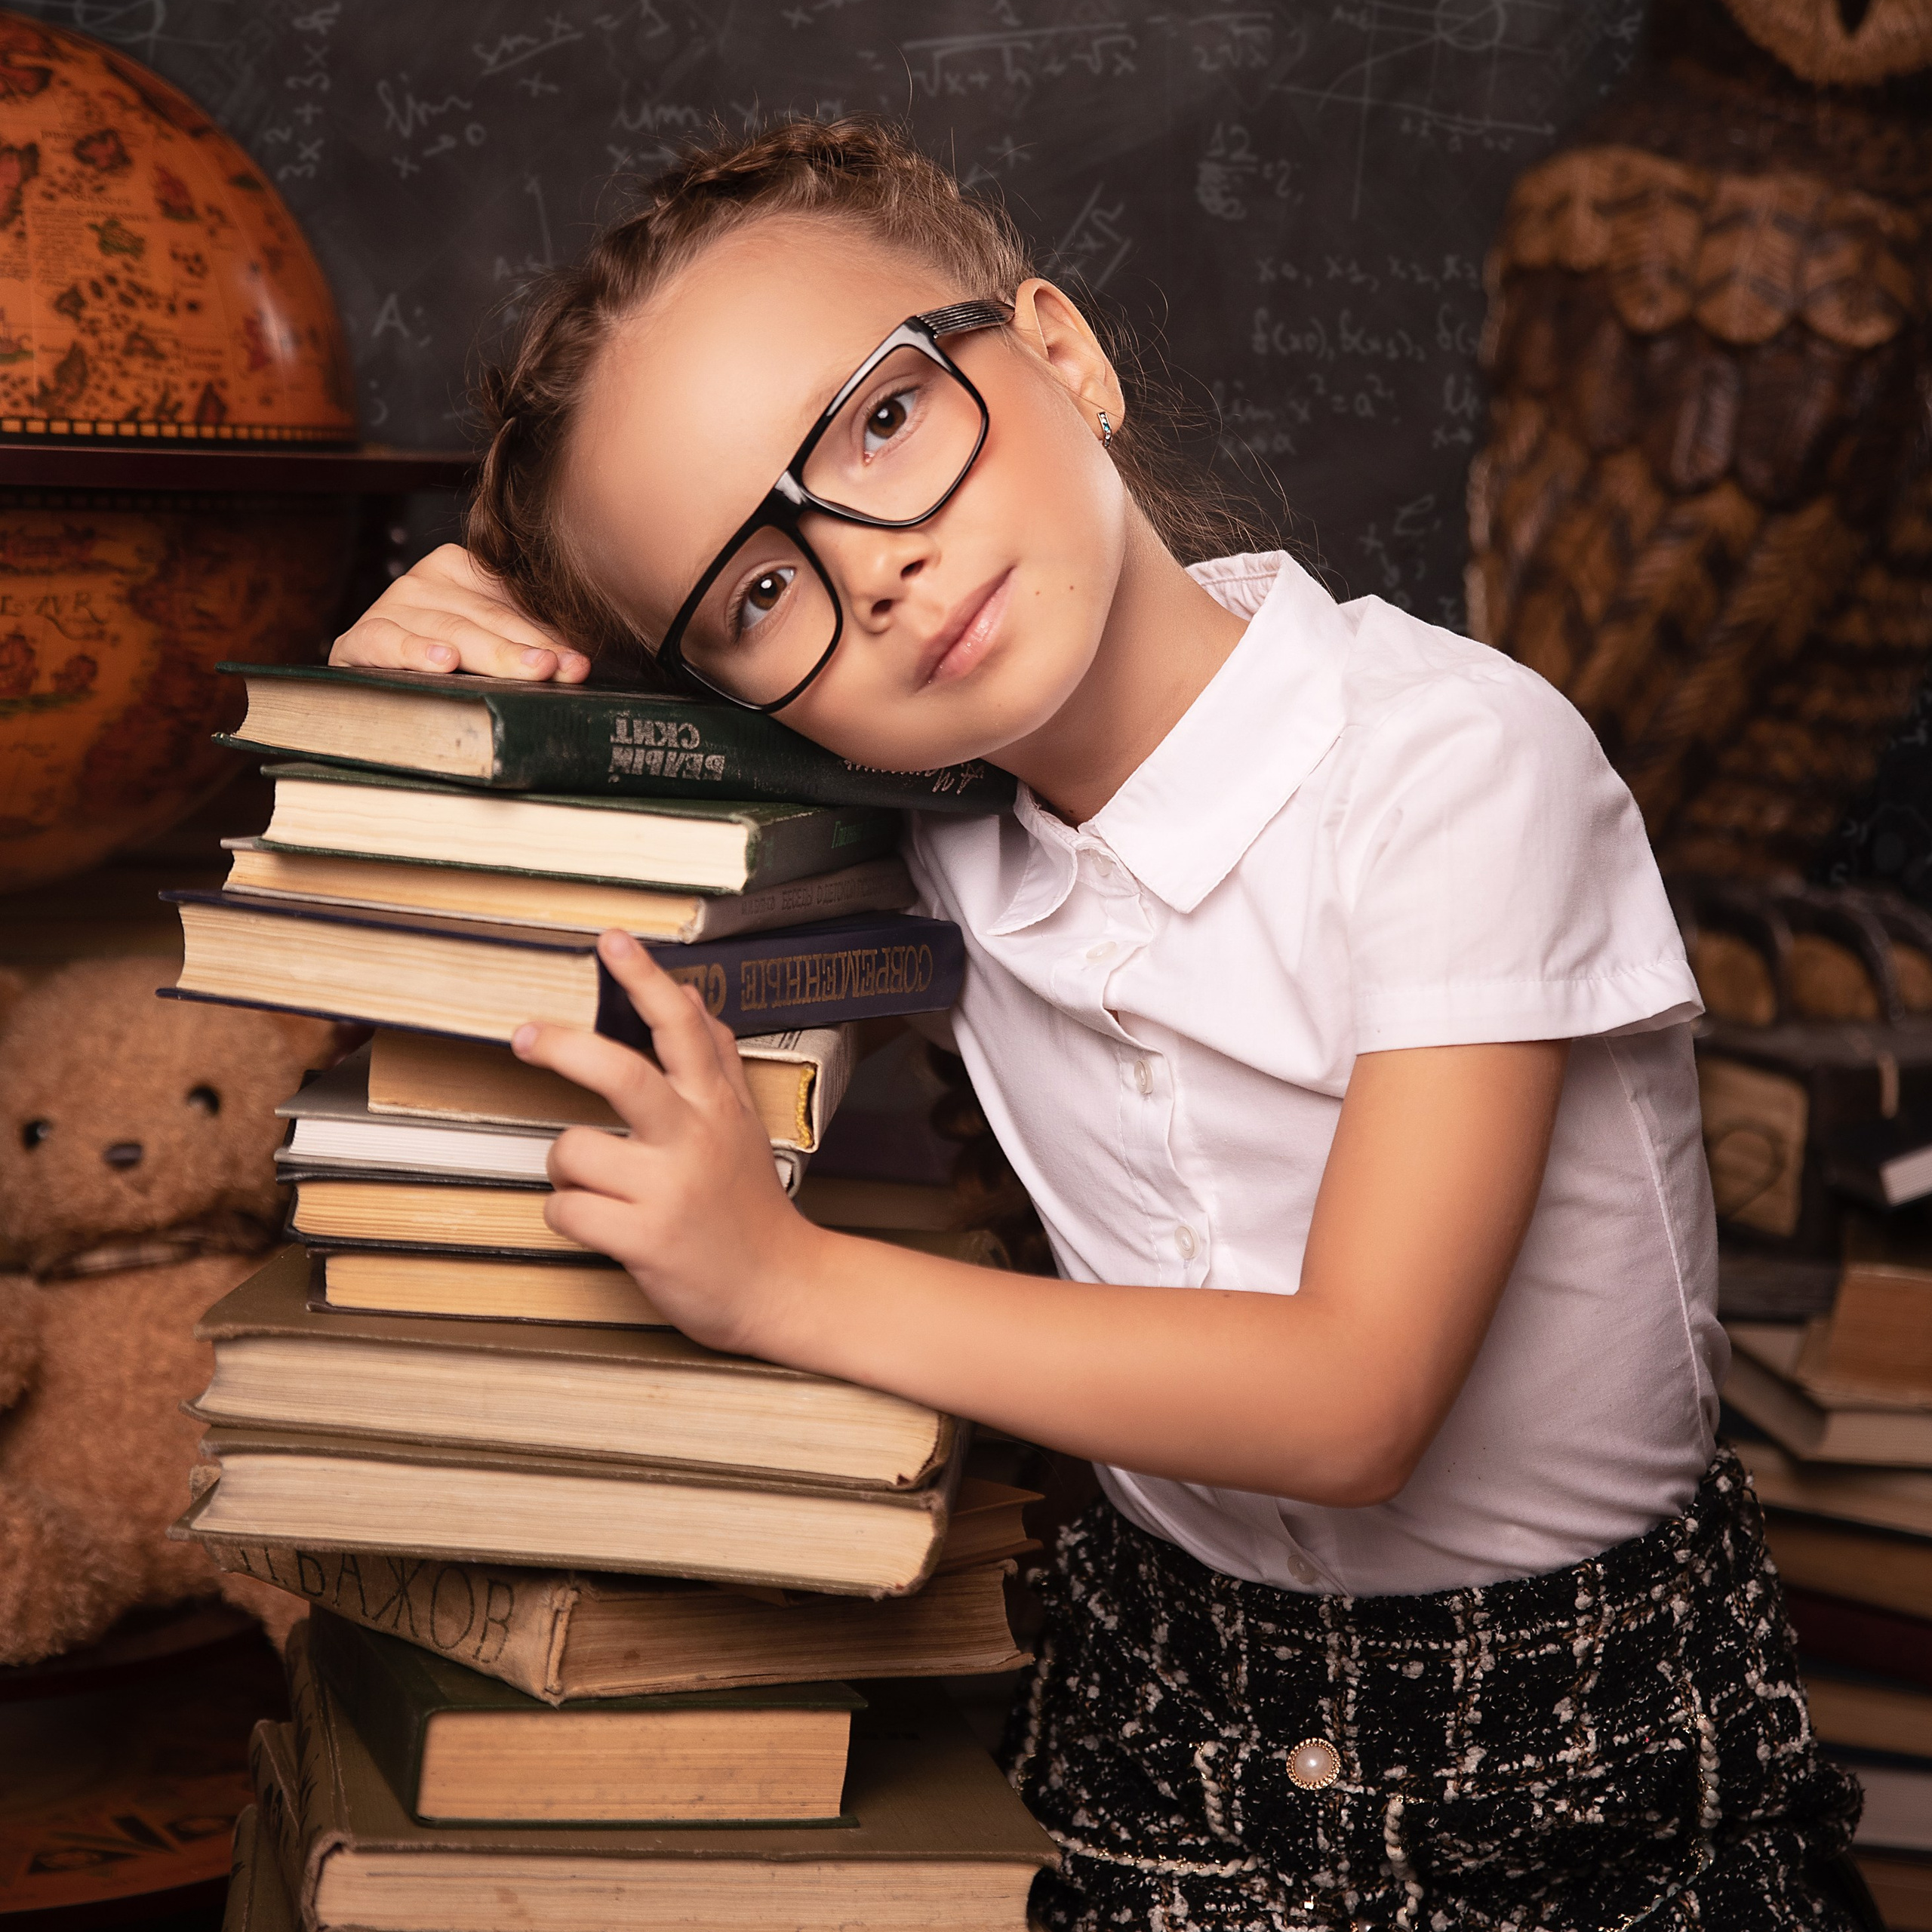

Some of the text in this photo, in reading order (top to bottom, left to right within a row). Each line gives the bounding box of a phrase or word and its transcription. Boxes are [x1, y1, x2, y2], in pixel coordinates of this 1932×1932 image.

[610, 718, 700, 750] СКИТ
[608, 746, 725, 783] БЕЛЫЙ
[740, 944, 933, 1011] СОВРЕМЕННЫЕ
